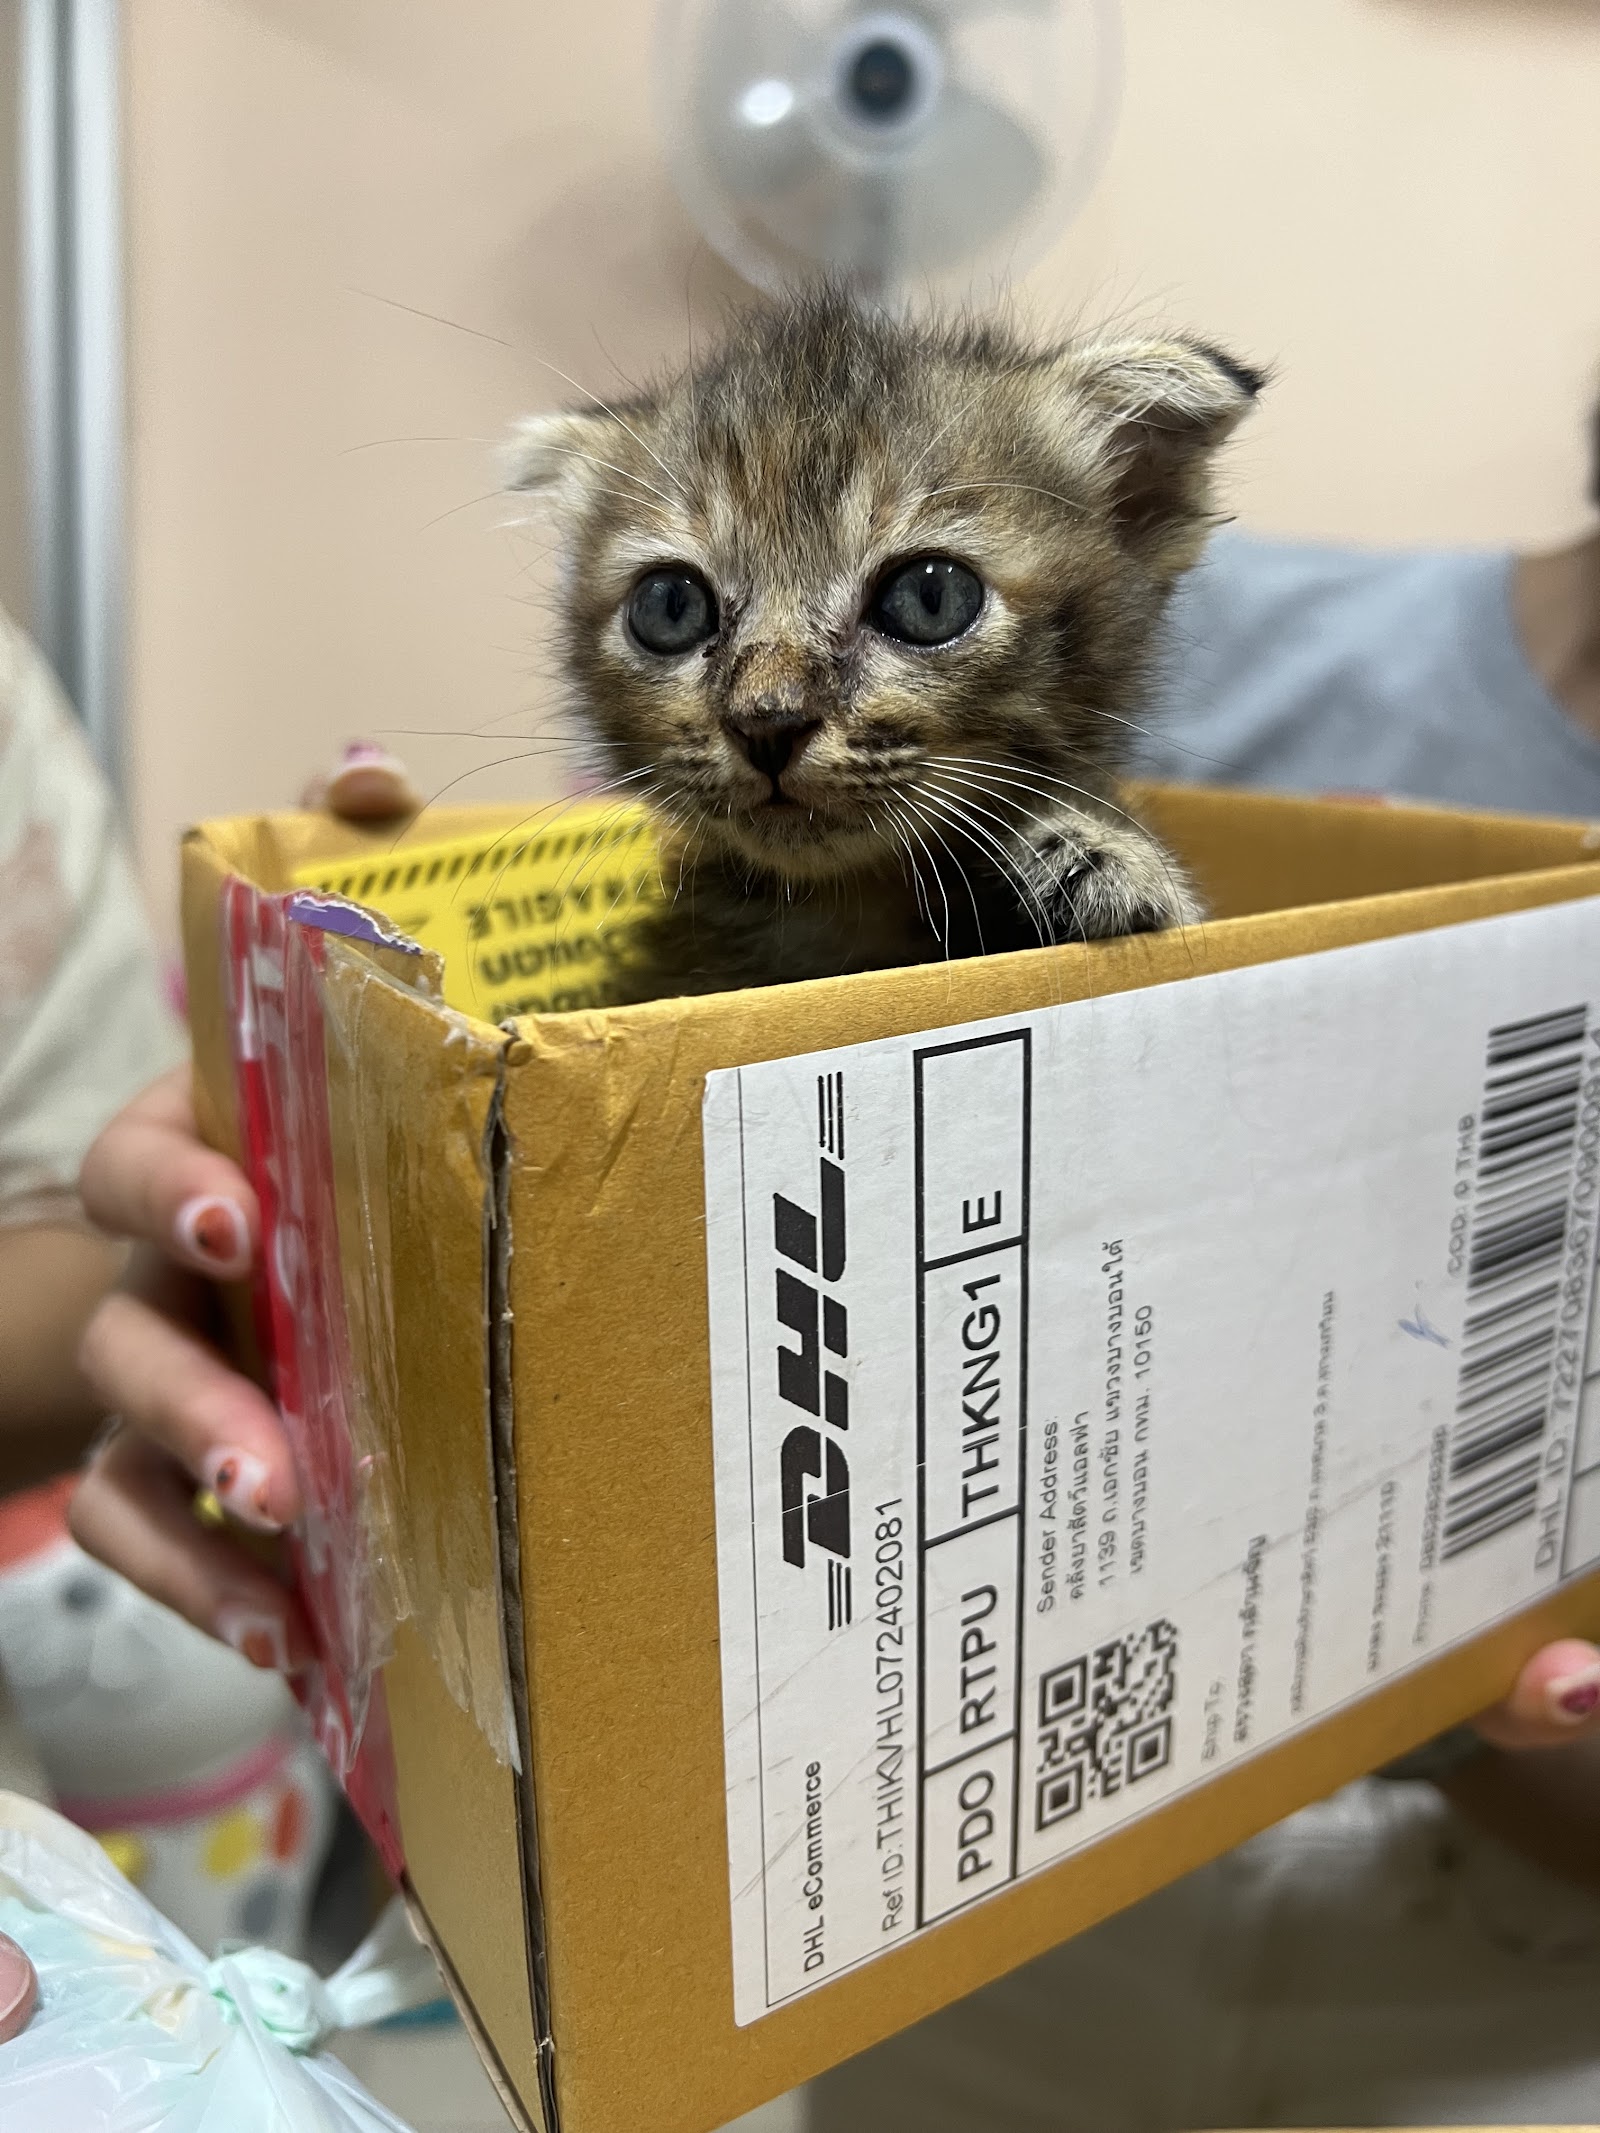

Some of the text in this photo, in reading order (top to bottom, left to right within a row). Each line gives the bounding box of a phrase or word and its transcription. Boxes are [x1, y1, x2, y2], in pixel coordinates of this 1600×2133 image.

[1456, 1113, 1475, 1173] THB
[962, 1189, 1002, 1233] E
[773, 1155, 851, 1567] DHL
[1134, 1304, 1153, 1377] 10150
[961, 1270, 1003, 1516] THKNG1
[1098, 1530, 1115, 1585] 1139
[1533, 1486, 1564, 1568] DHL
[1037, 1529, 1057, 1612] Sender
[960, 1586, 1000, 1733] RTPU
[802, 1760, 825, 1970] DHL eCommerce
[956, 1770, 996, 1880] PDO
[881, 1888, 903, 1930] Ref
